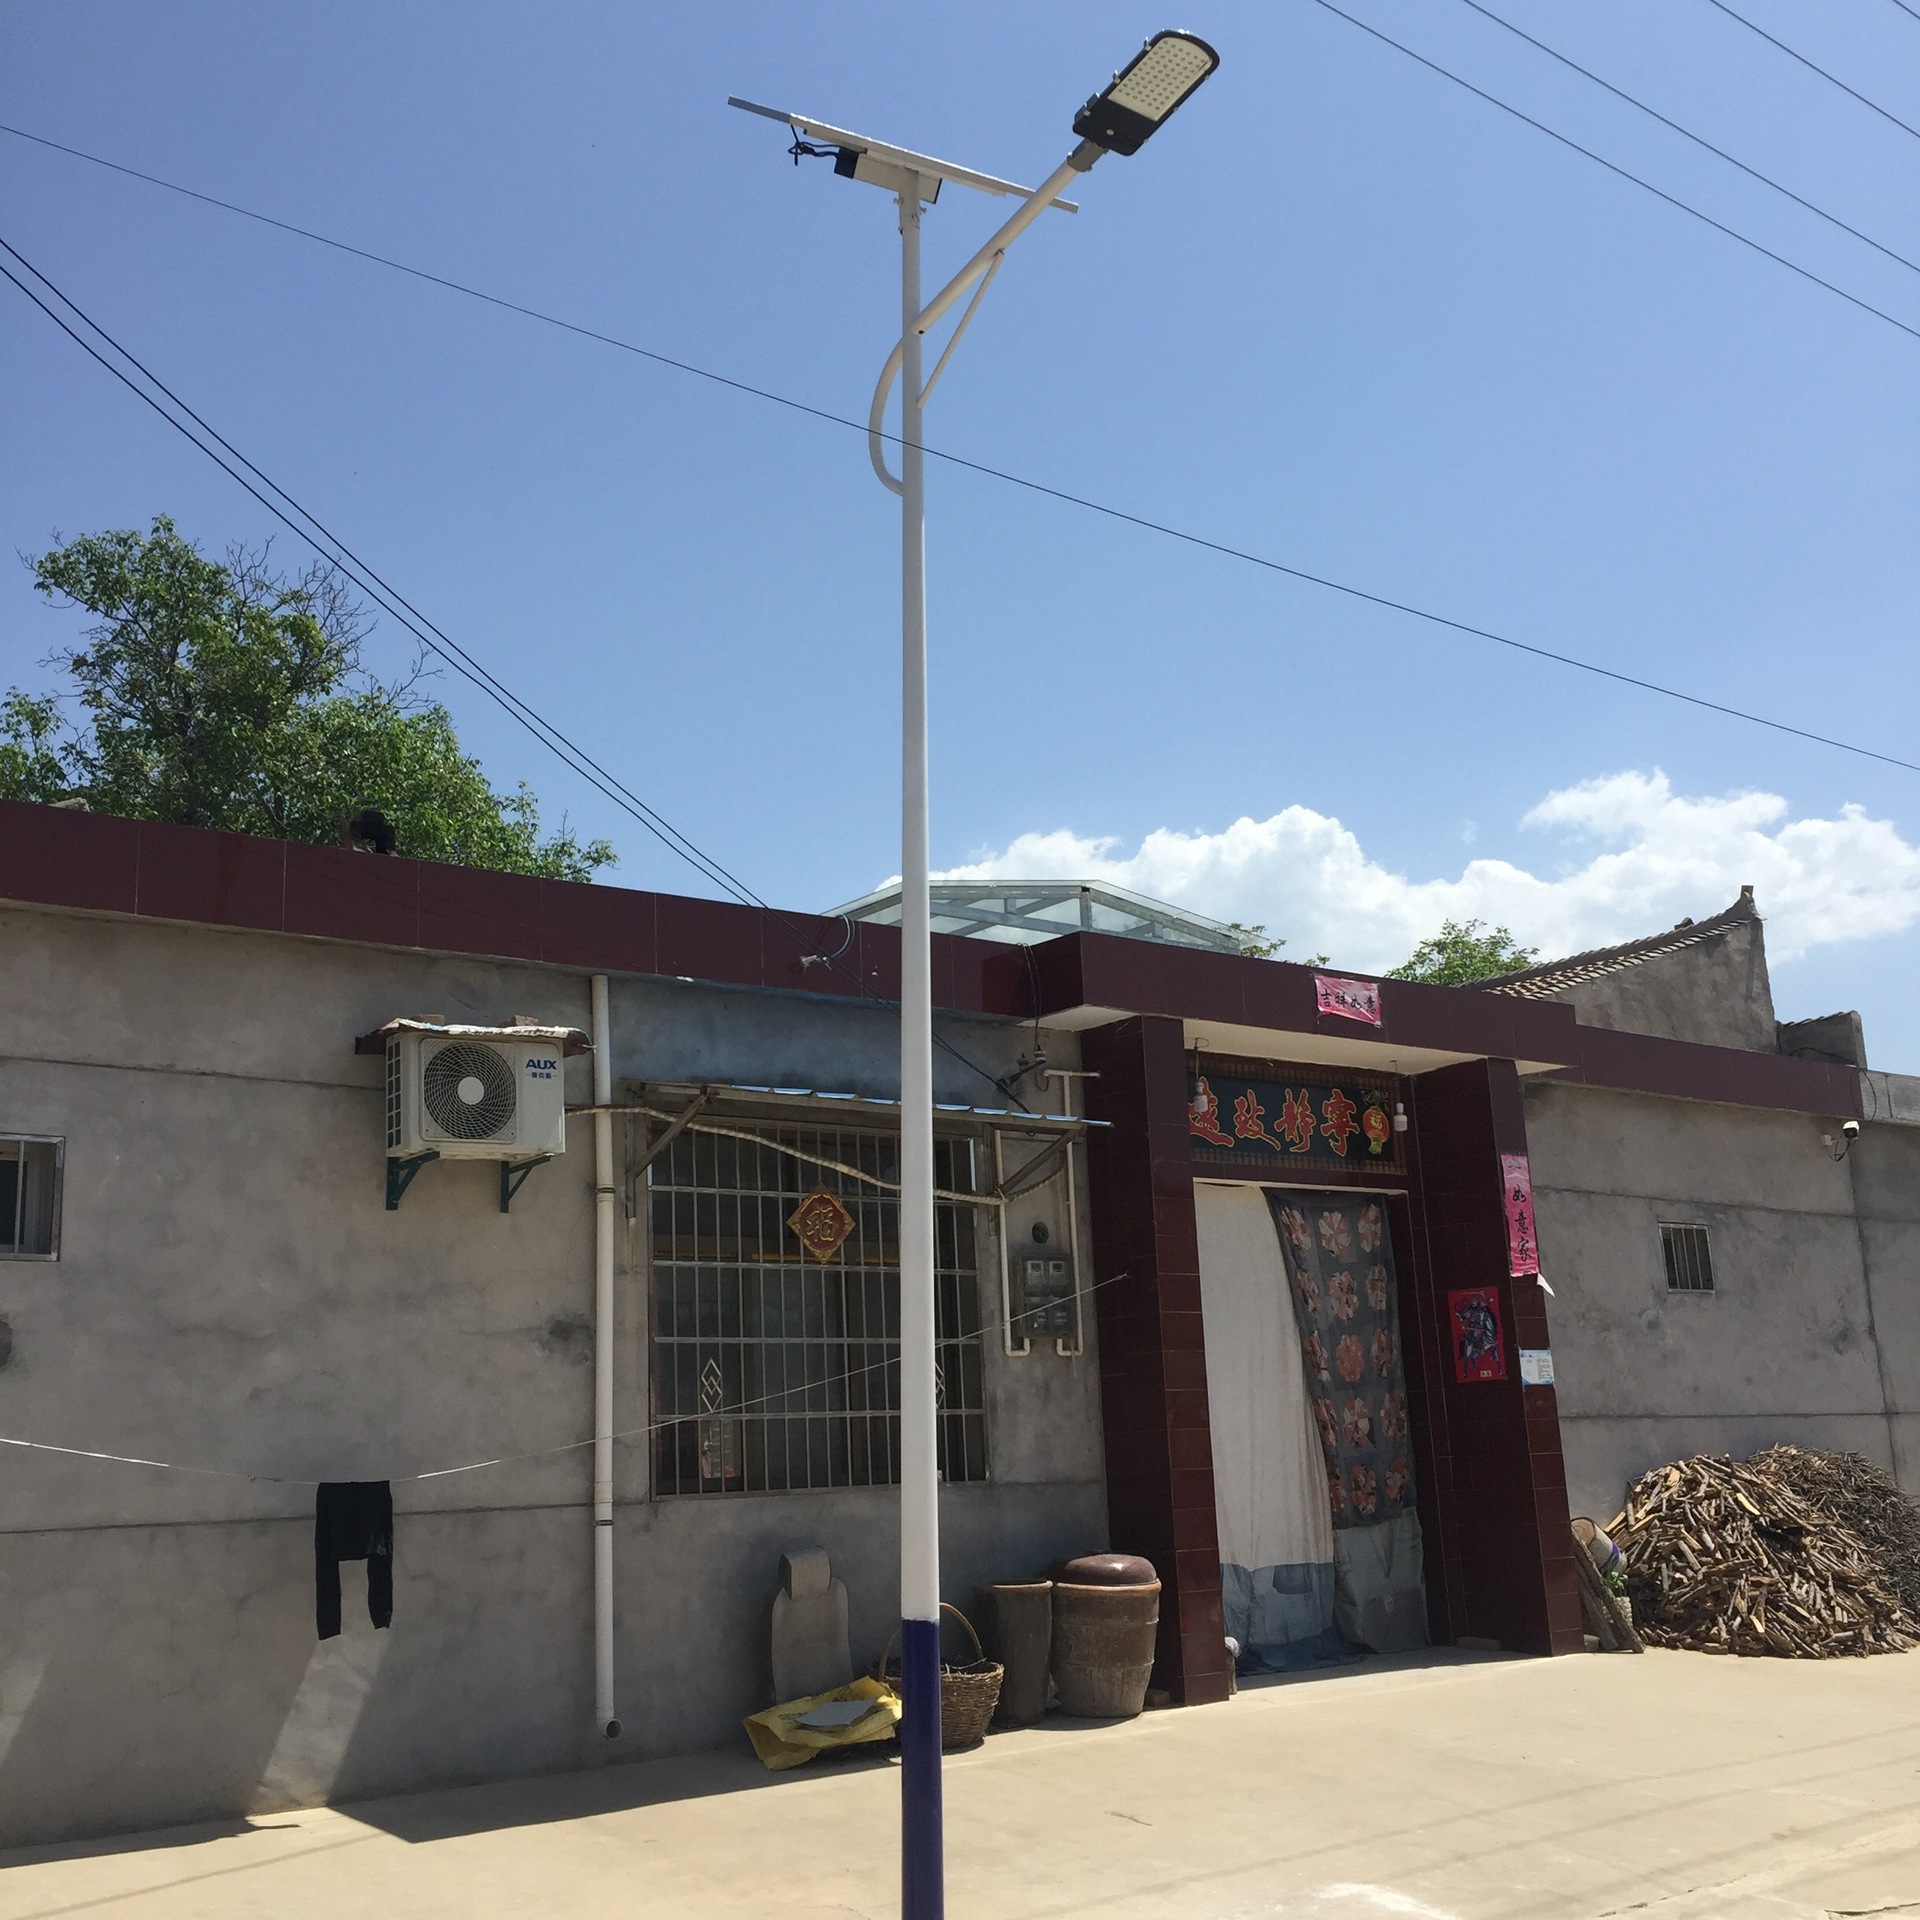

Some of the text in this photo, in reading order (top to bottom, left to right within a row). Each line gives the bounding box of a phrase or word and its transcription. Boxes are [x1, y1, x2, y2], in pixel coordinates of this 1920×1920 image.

[1320, 988, 1377, 1015] 吉祥如意
[525, 1059, 557, 1070] AUX
